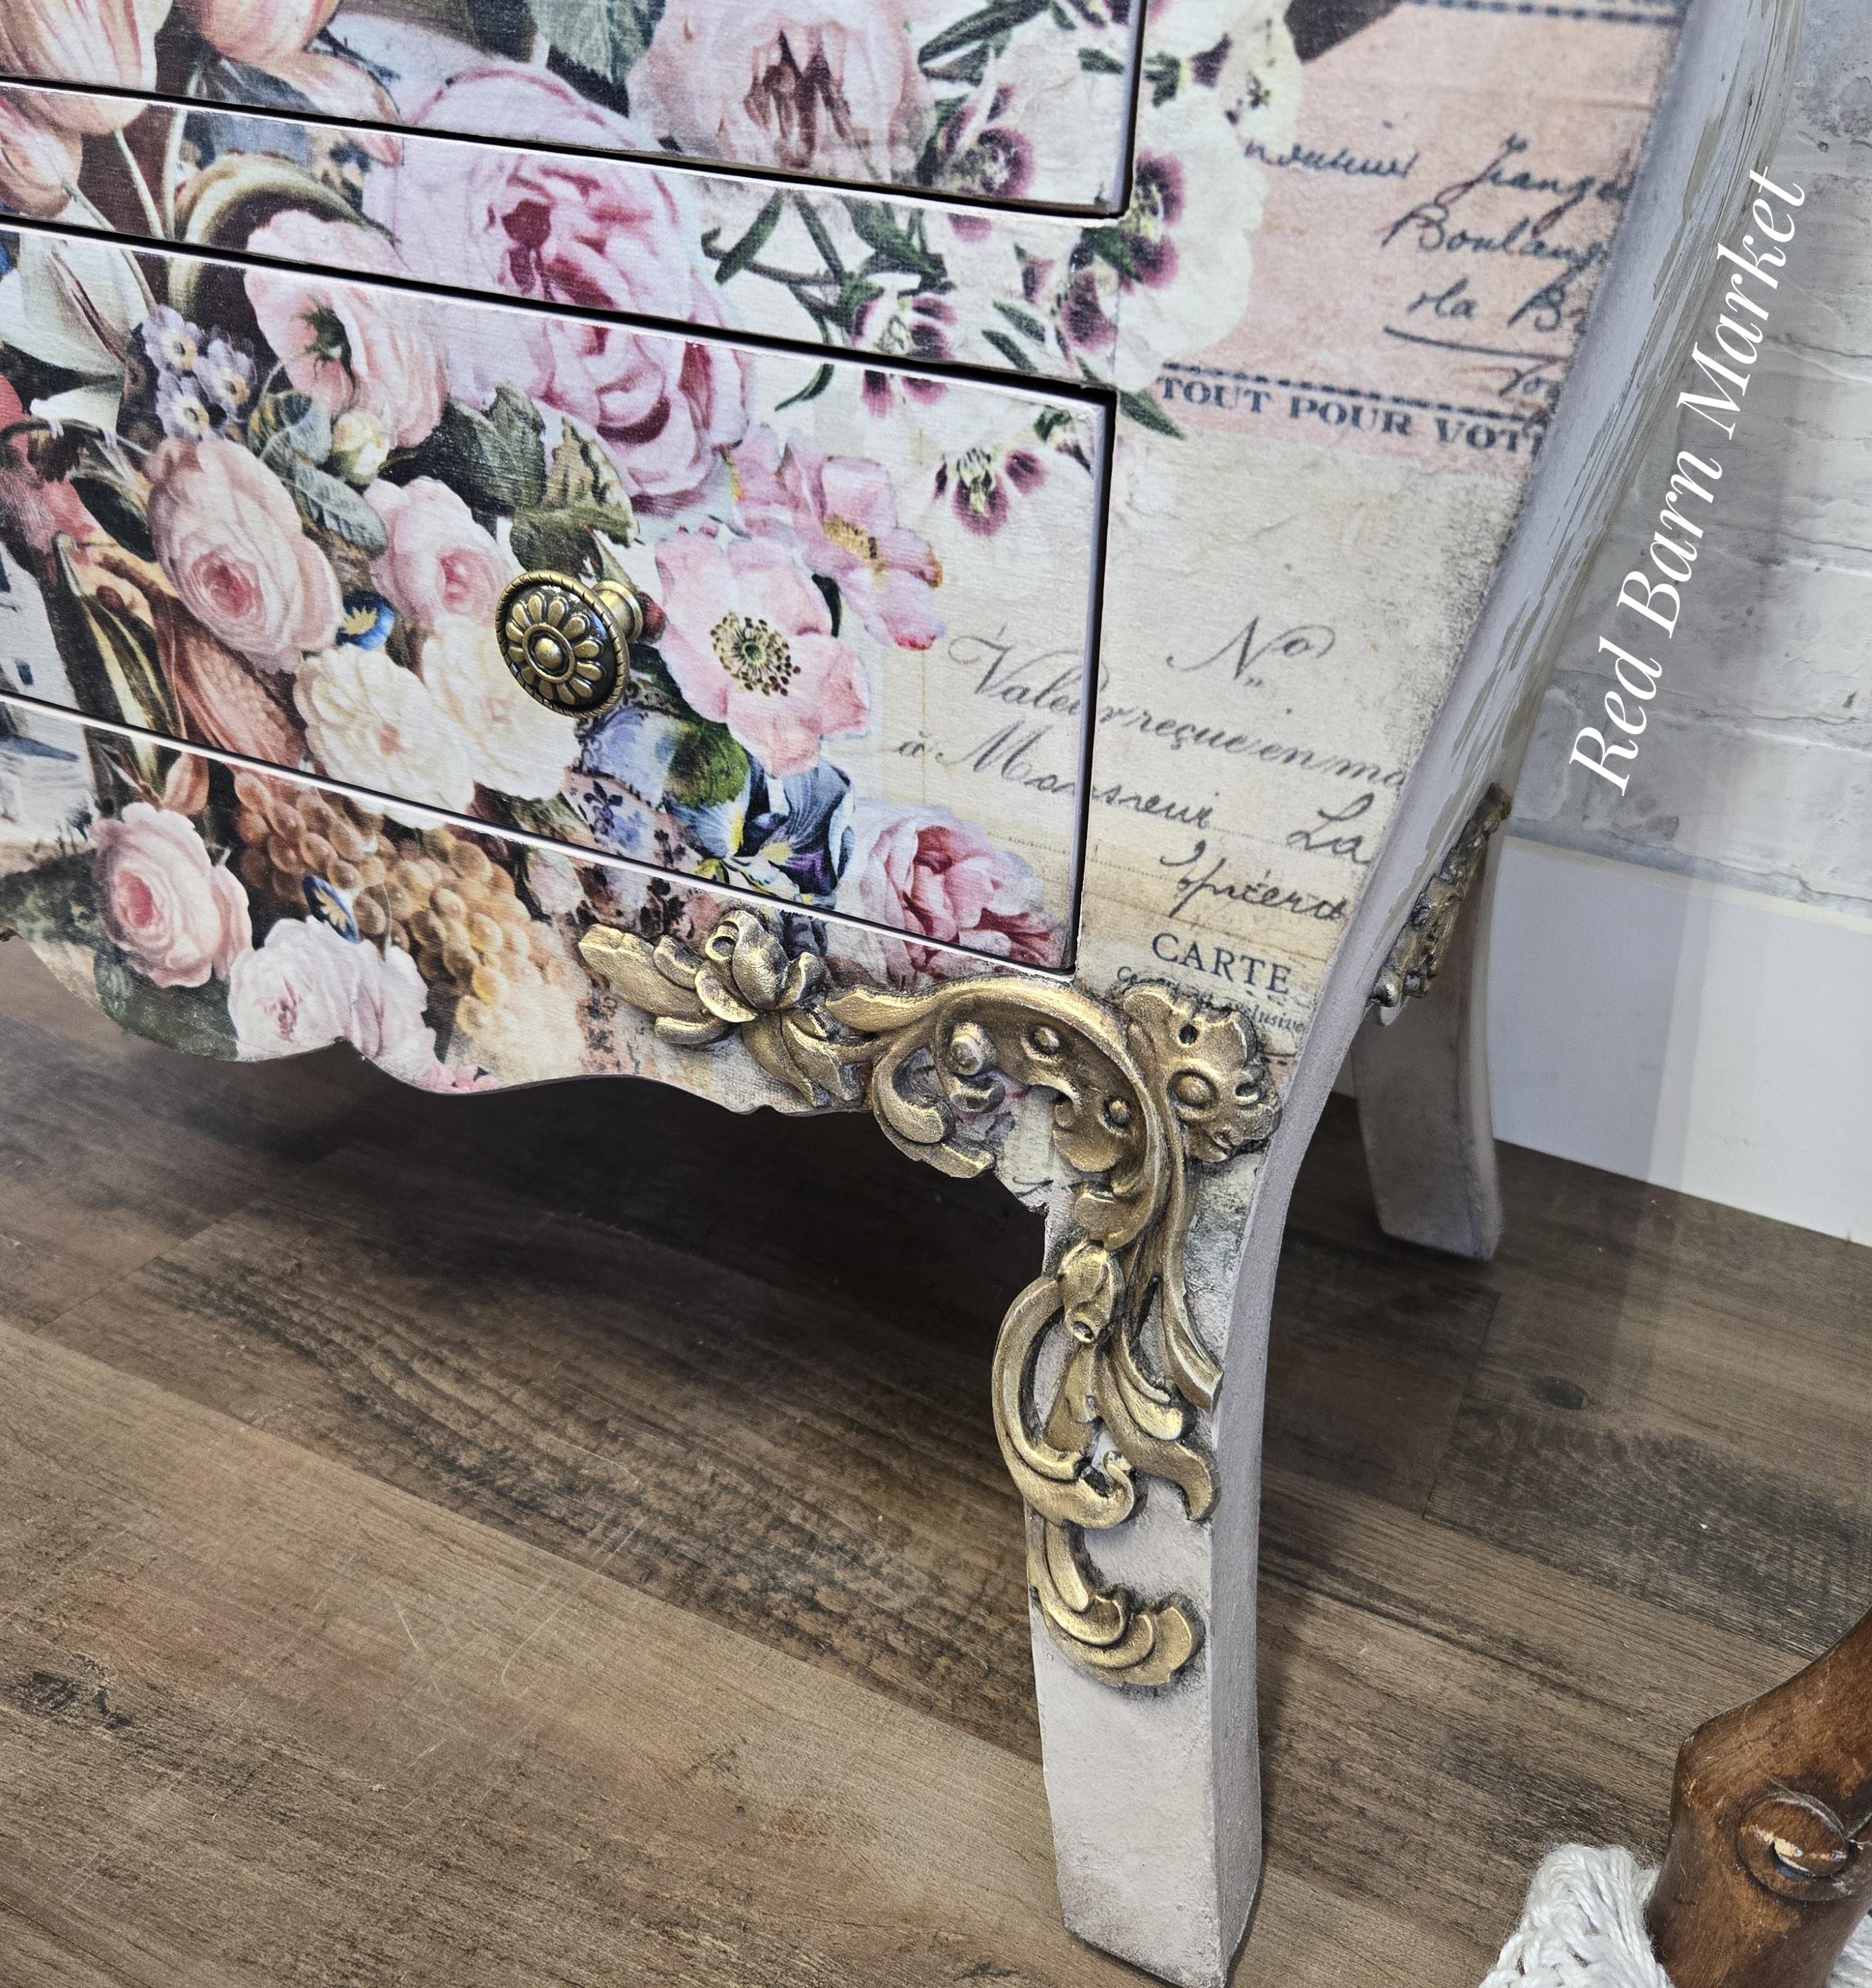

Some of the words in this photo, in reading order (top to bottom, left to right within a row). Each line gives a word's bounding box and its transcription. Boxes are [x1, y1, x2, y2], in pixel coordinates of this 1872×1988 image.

[1157, 375, 1271, 414] TOUT
[1291, 395, 1412, 436] POUR
[1152, 933, 1293, 995] CARTE
